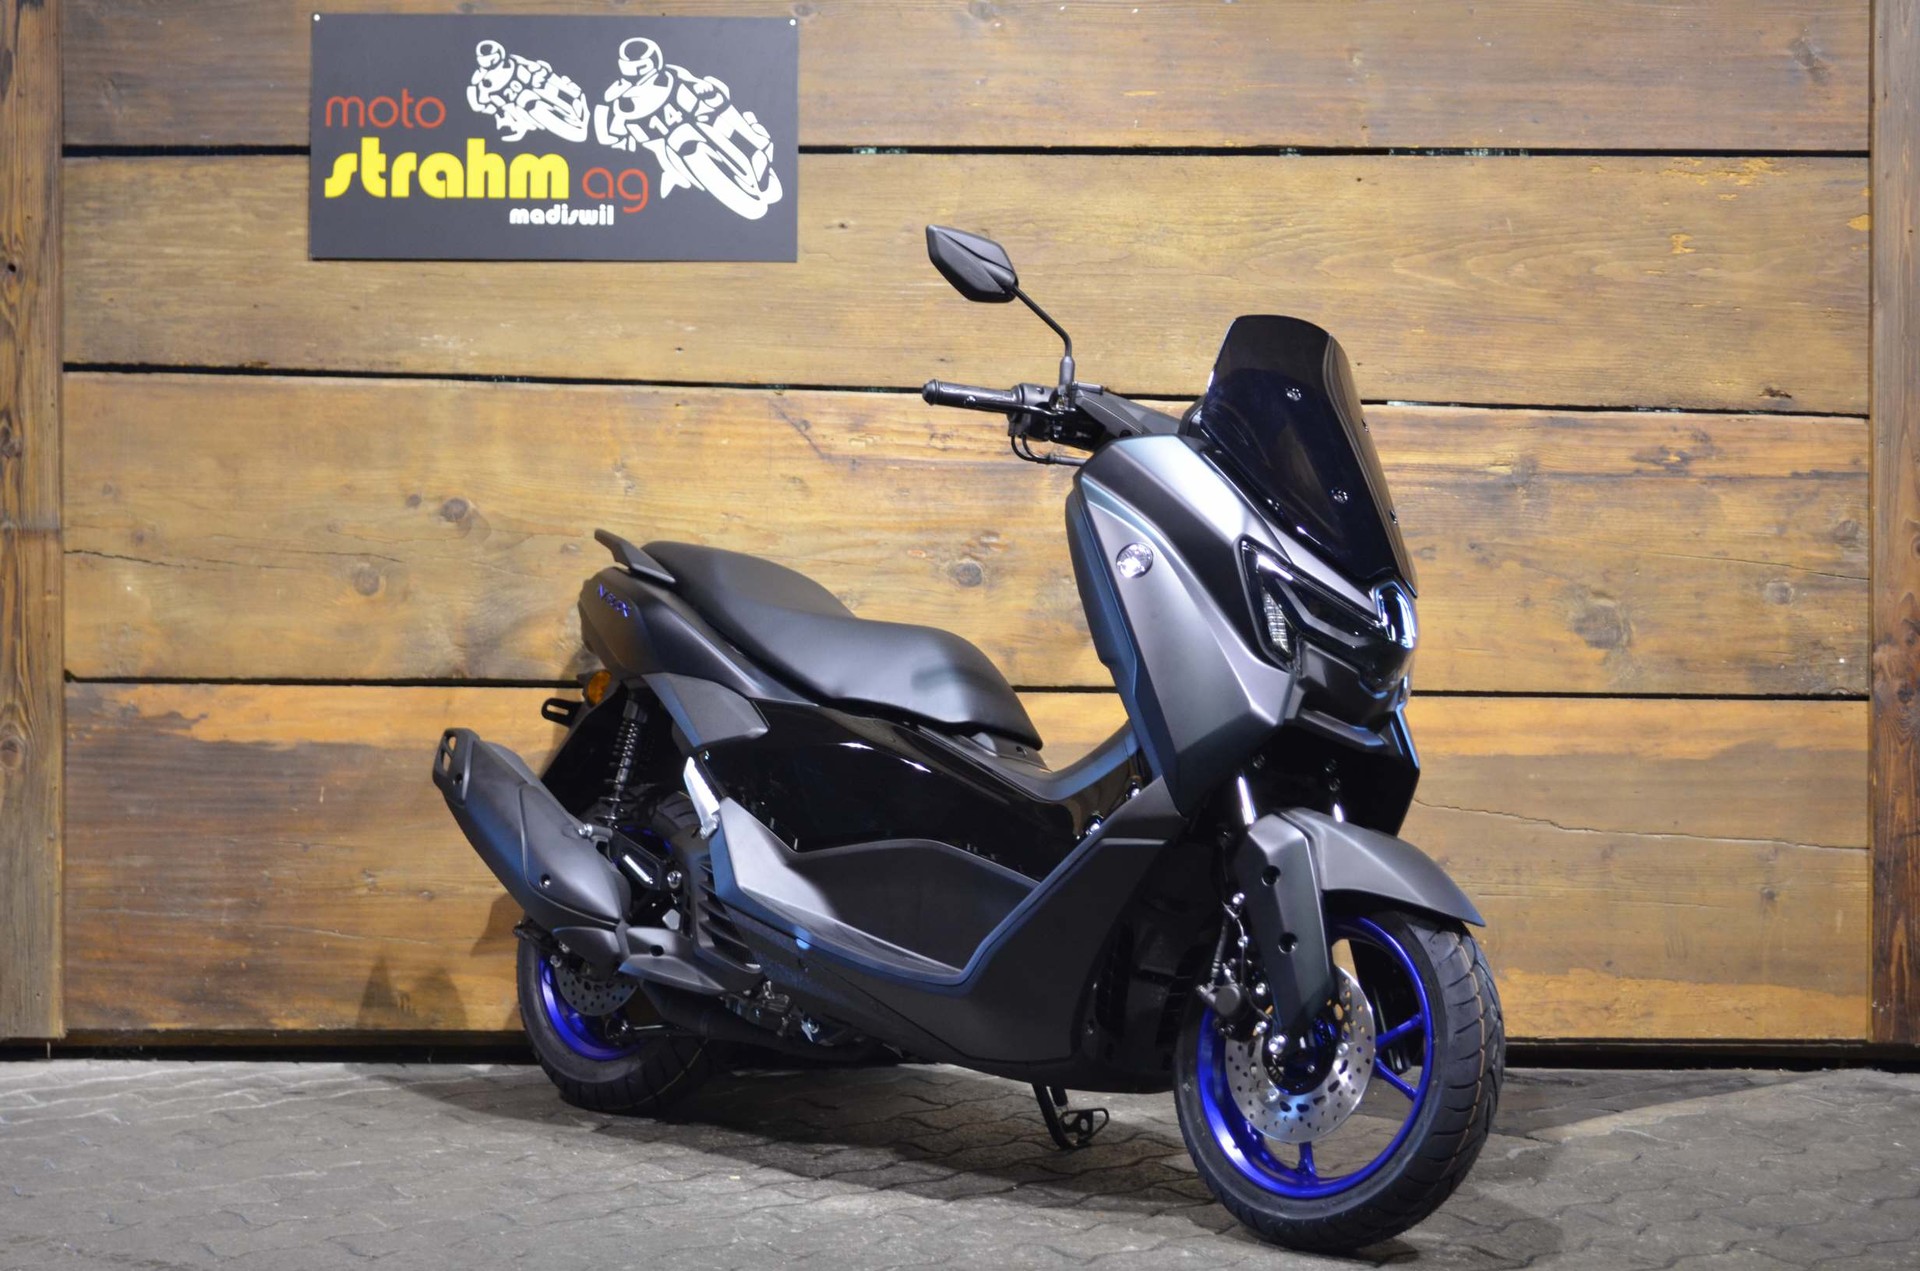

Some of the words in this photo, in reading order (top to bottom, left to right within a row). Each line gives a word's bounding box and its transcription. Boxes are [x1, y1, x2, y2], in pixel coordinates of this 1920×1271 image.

[503, 80, 523, 102] 20
[325, 88, 446, 128] moto
[649, 103, 683, 135] 14
[324, 137, 570, 199] strahm
[581, 167, 649, 213] ag
[509, 204, 614, 226] madiswil
